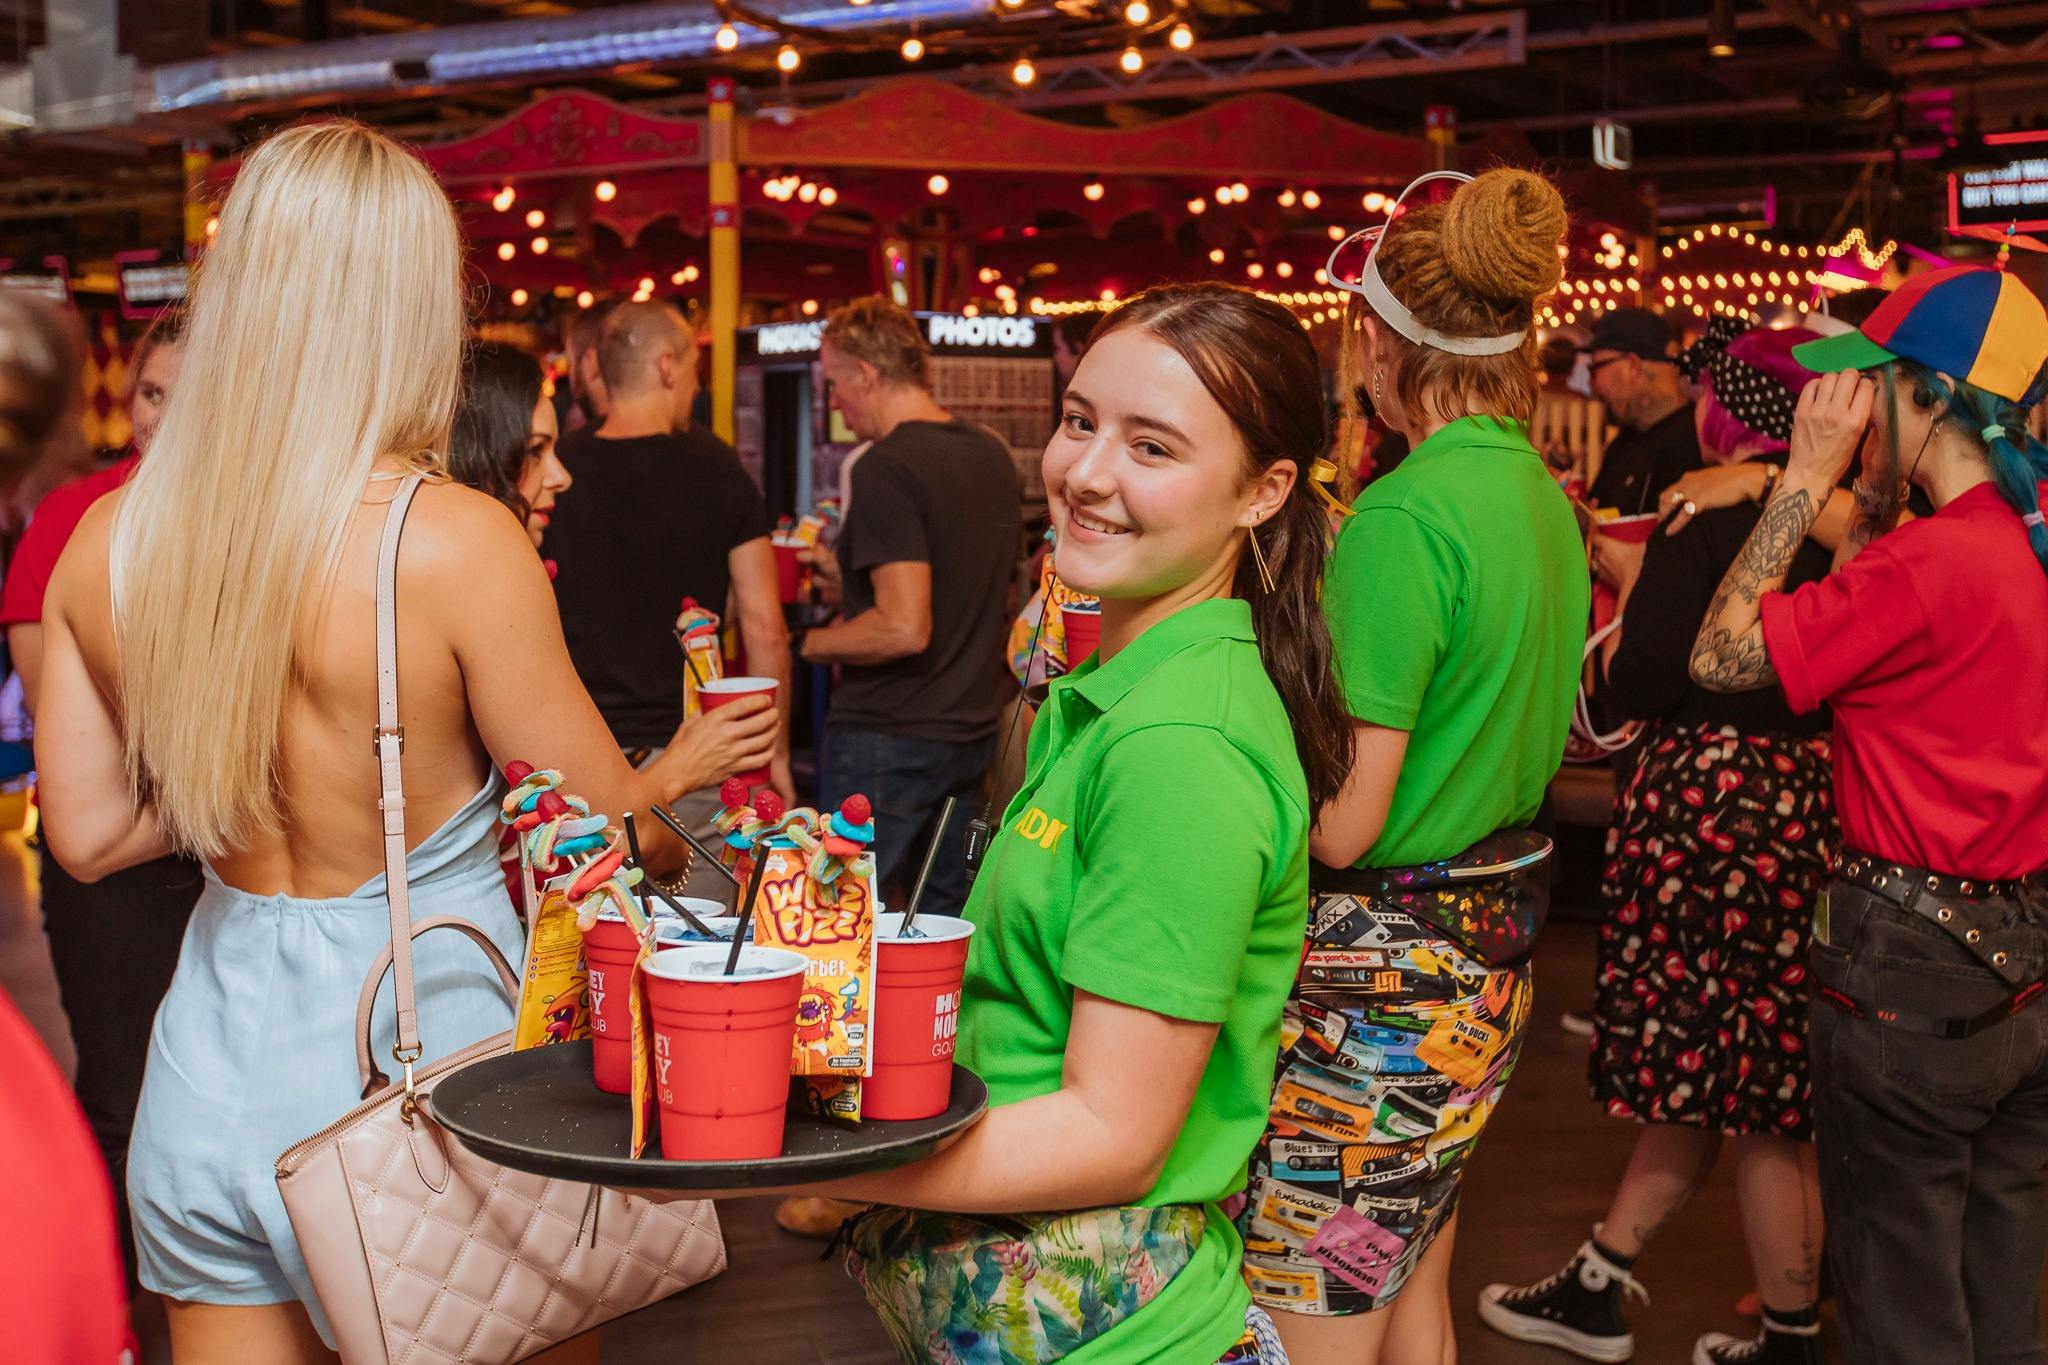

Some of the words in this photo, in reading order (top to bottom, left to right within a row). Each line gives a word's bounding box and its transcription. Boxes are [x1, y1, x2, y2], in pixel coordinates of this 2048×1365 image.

[929, 315, 1035, 348] PHOTOS
[764, 872, 865, 912] WIZ
[778, 905, 857, 945] FIZZ
[805, 959, 846, 977] rbet
[935, 988, 962, 1015] HO
